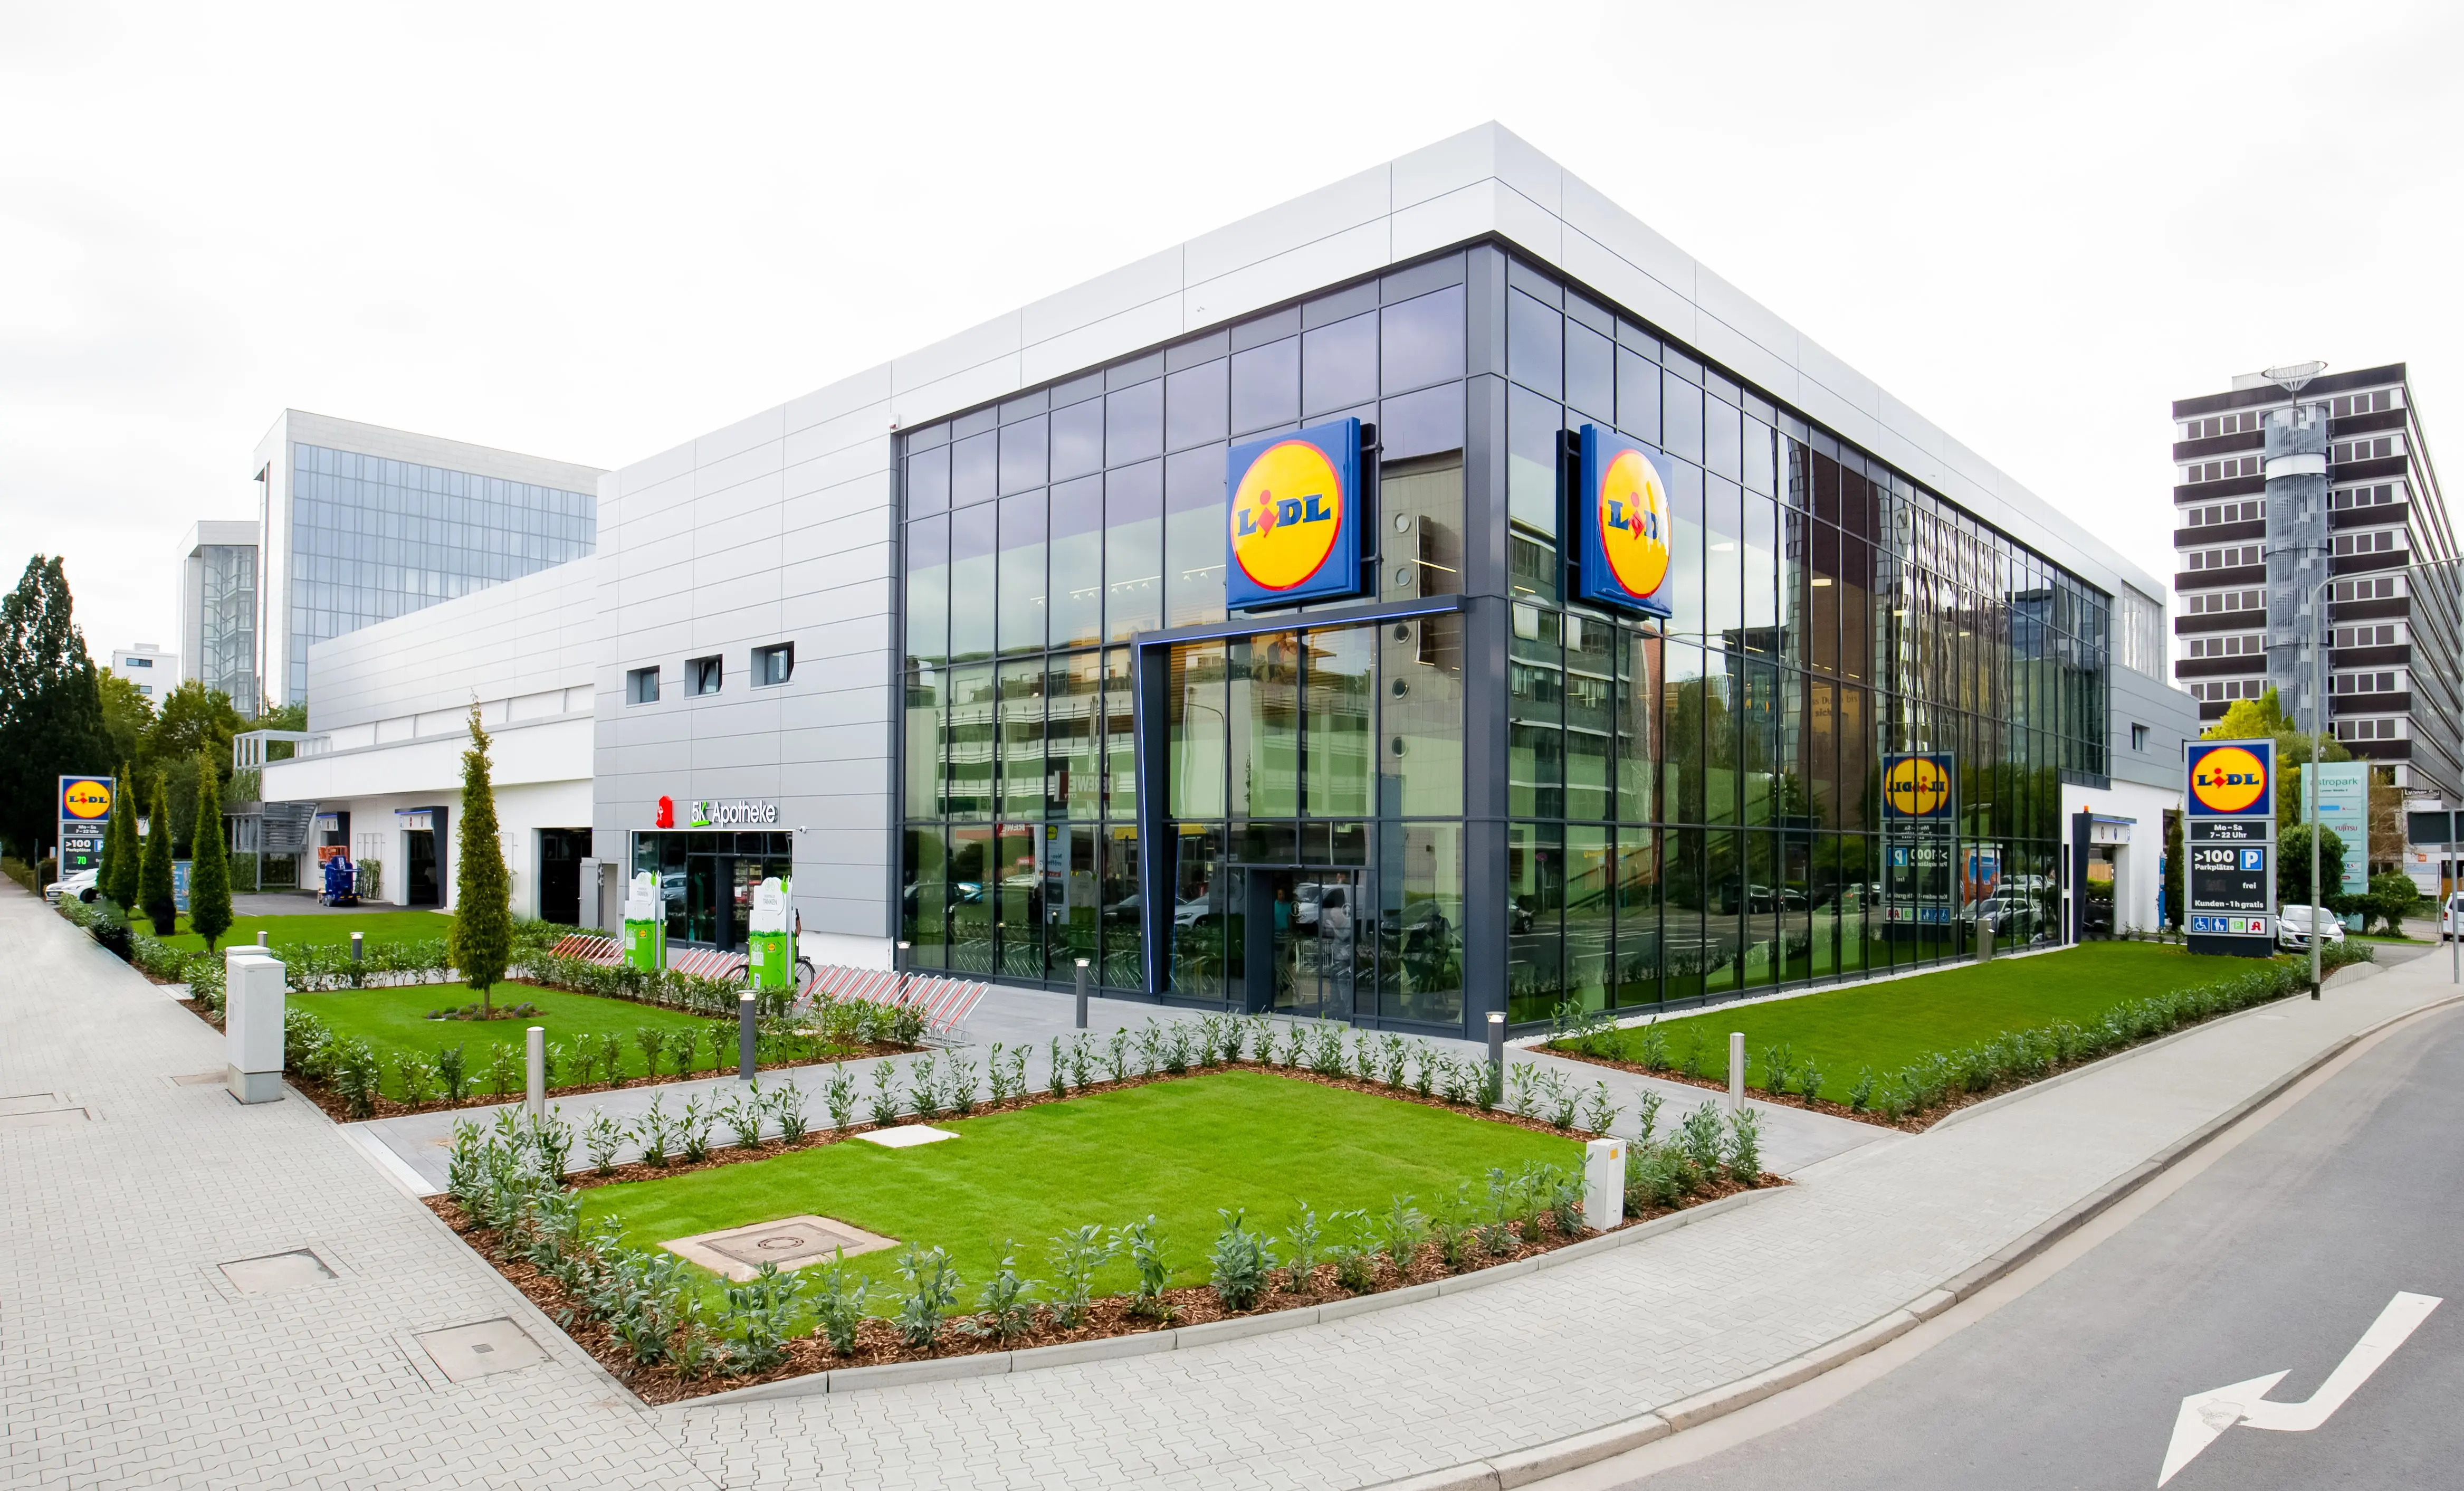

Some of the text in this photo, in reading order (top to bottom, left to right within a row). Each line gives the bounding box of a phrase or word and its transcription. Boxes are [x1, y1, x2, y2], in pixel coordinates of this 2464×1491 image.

[712, 800, 776, 828] Apotheke
[65, 840, 91, 848] >100
[77, 856, 87, 865] 70
[2194, 849, 2234, 863] >100
[2245, 851, 2259, 868] P
[2241, 900, 2264, 909] gratis
